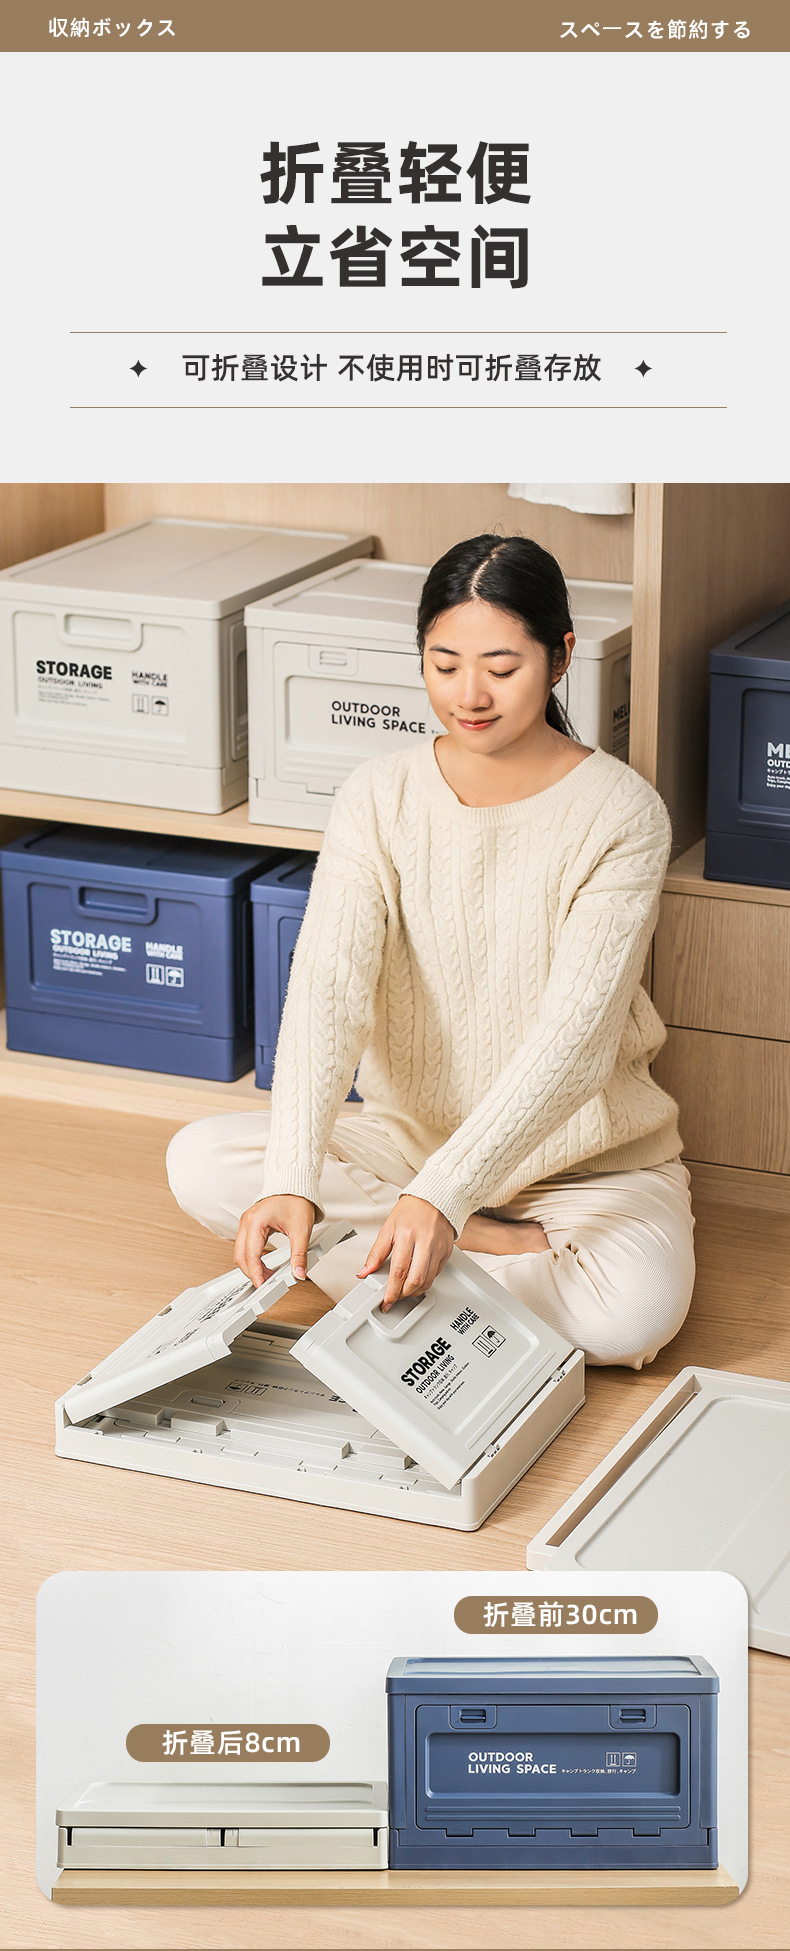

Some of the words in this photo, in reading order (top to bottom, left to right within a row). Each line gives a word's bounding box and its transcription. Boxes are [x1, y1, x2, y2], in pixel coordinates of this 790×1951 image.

[36, 660, 112, 680] STORAGE
[331, 700, 401, 717] OUTDOOR
[331, 713, 376, 728] LIVING
[382, 719, 426, 734] SPACE
[50, 928, 132, 953] STORAGE
[145, 941, 183, 953] HANDLE
[449, 1306, 474, 1331] HANDLE
[457, 1323, 471, 1335] WITH
[400, 1336, 452, 1387] STORAGE
[415, 1369, 441, 1394] OUTDOOR
[436, 1354, 455, 1372] LIVING
[468, 1752, 534, 1762] OUTDOOR
[468, 1764, 511, 1774] LIVING
[516, 1764, 557, 1774] SPACE
